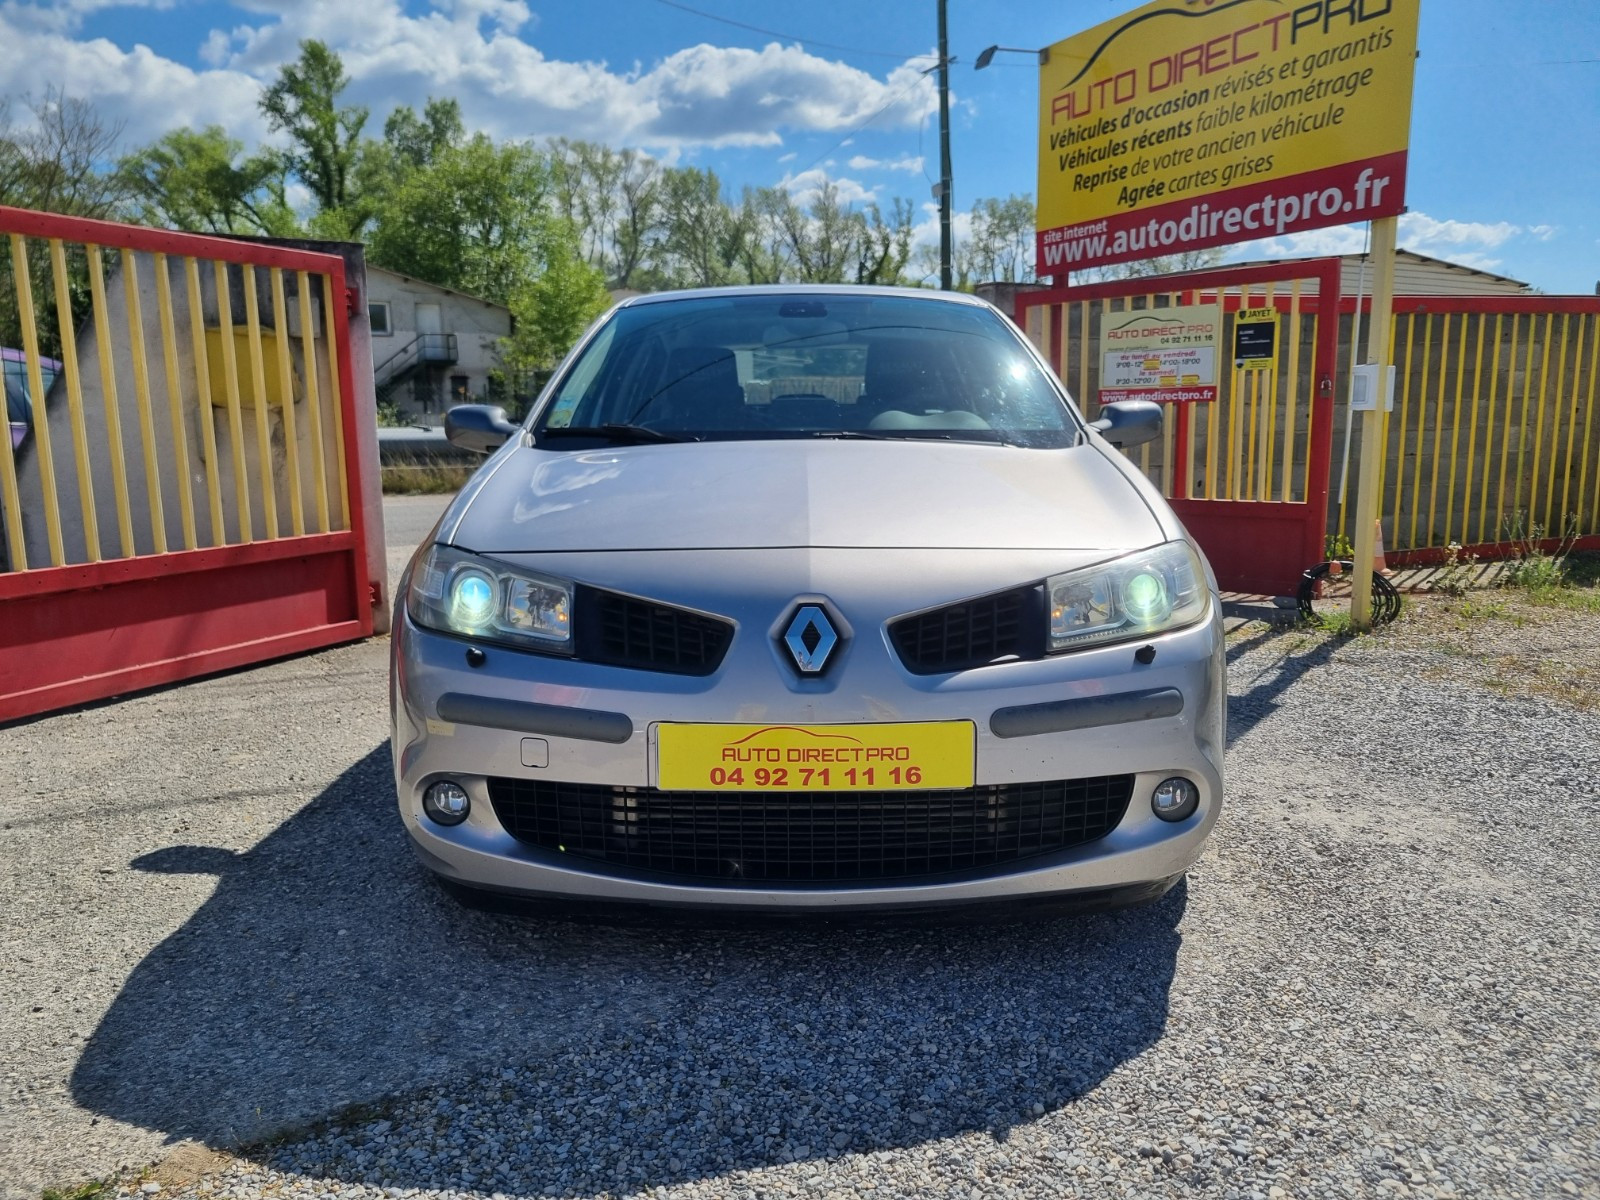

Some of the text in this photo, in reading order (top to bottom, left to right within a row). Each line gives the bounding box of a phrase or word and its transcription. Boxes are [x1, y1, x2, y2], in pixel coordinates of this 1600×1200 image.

[1050, 26, 1394, 151] Véhicules d'occasion révisés et garantis
[1052, 69, 1136, 125] AUTO
[1059, 67, 1373, 172] Véhicules récents faible kilométrage
[1073, 103, 1345, 193] Reprise de votre ancien véhicule
[1117, 155, 1274, 207] Agrée cartes grises
[1044, 168, 1390, 266] www.autodirectpro.fr
[1044, 220, 1107, 244] site internet
[1247, 310, 1271, 318] JAYET
[1107, 330, 1139, 340] AUTO
[1101, 390, 1213, 402] www.autodirectpro.fr
[722, 747, 780, 762] AUTO
[710, 766, 922, 786] 04 92 71 11 16
